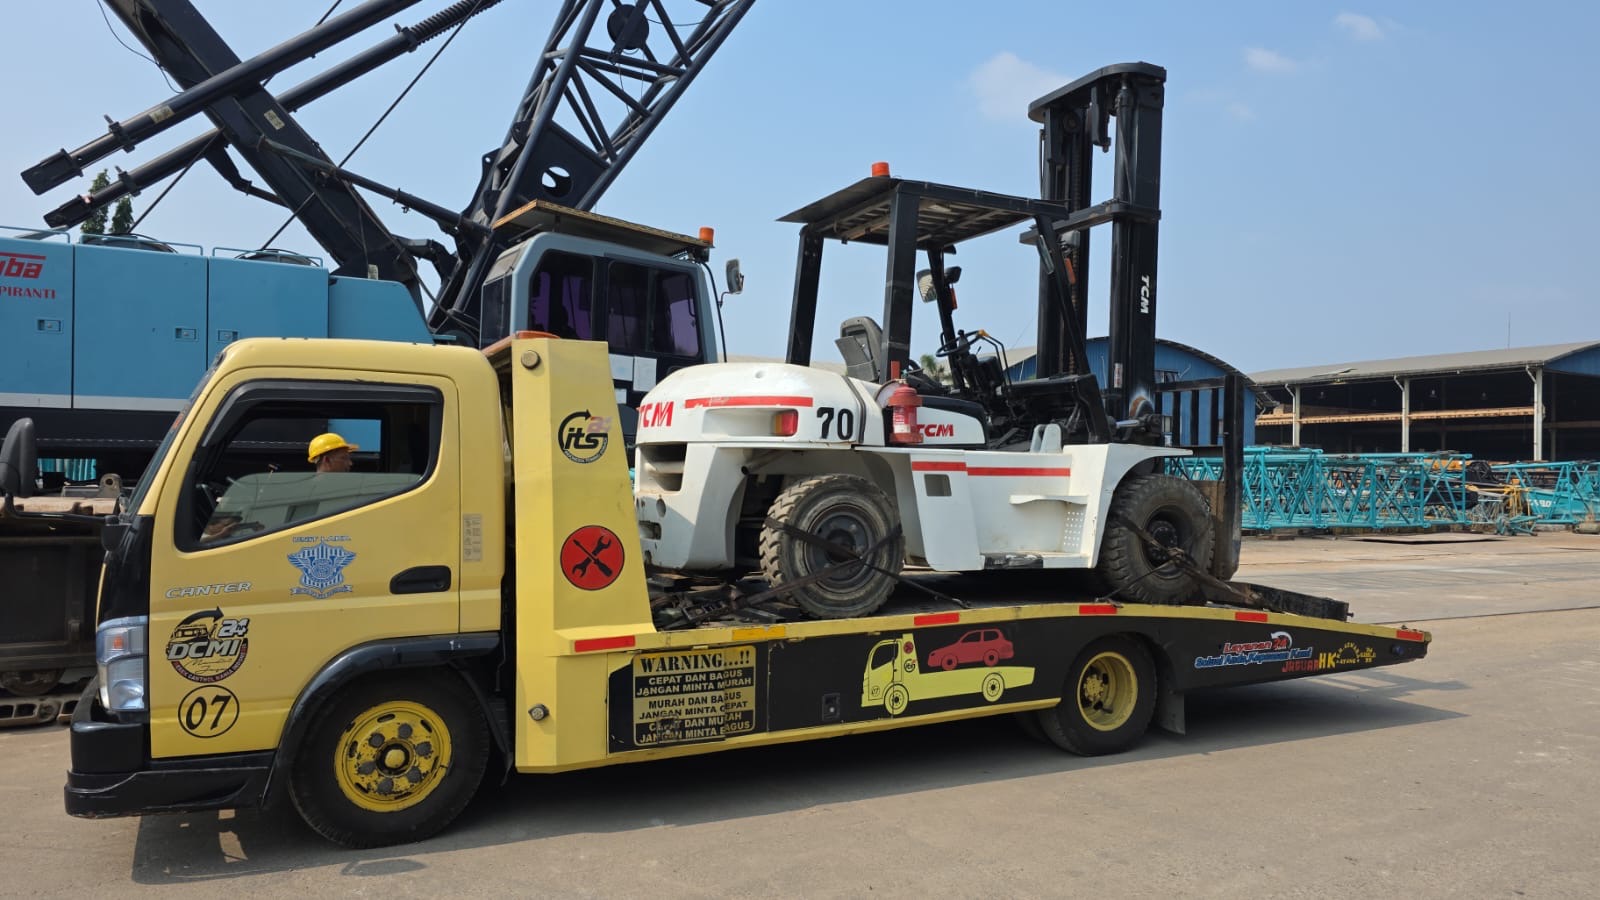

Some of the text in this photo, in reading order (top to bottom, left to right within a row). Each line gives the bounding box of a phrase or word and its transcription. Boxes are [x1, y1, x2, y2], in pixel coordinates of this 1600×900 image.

[1141, 275, 1150, 314] TCM
[636, 401, 674, 428] TCM
[817, 407, 854, 440] 70
[565, 427, 608, 449] its
[917, 424, 955, 437] TCM
[165, 582, 252, 598] CANTER
[218, 618, 250, 638] 24
[167, 638, 242, 661] DCMI
[640, 650, 750, 672] WARNING...!!
[1281, 659, 1319, 672] JAGUAR
[1319, 652, 1336, 668] HK
[636, 677, 751, 696] JANGAN MINTA MURAH
[648, 669, 743, 685] CEPAT DAN BAGUS
[648, 691, 742, 709] MURAH DAN BAGUS
[186, 695, 231, 730] 07
[639, 701, 748, 720] JANGAN MINTA CEPAT
[684, 718, 705, 728] DAN
[708, 712, 742, 726] MURAH
[685, 728, 717, 738] MINTA
